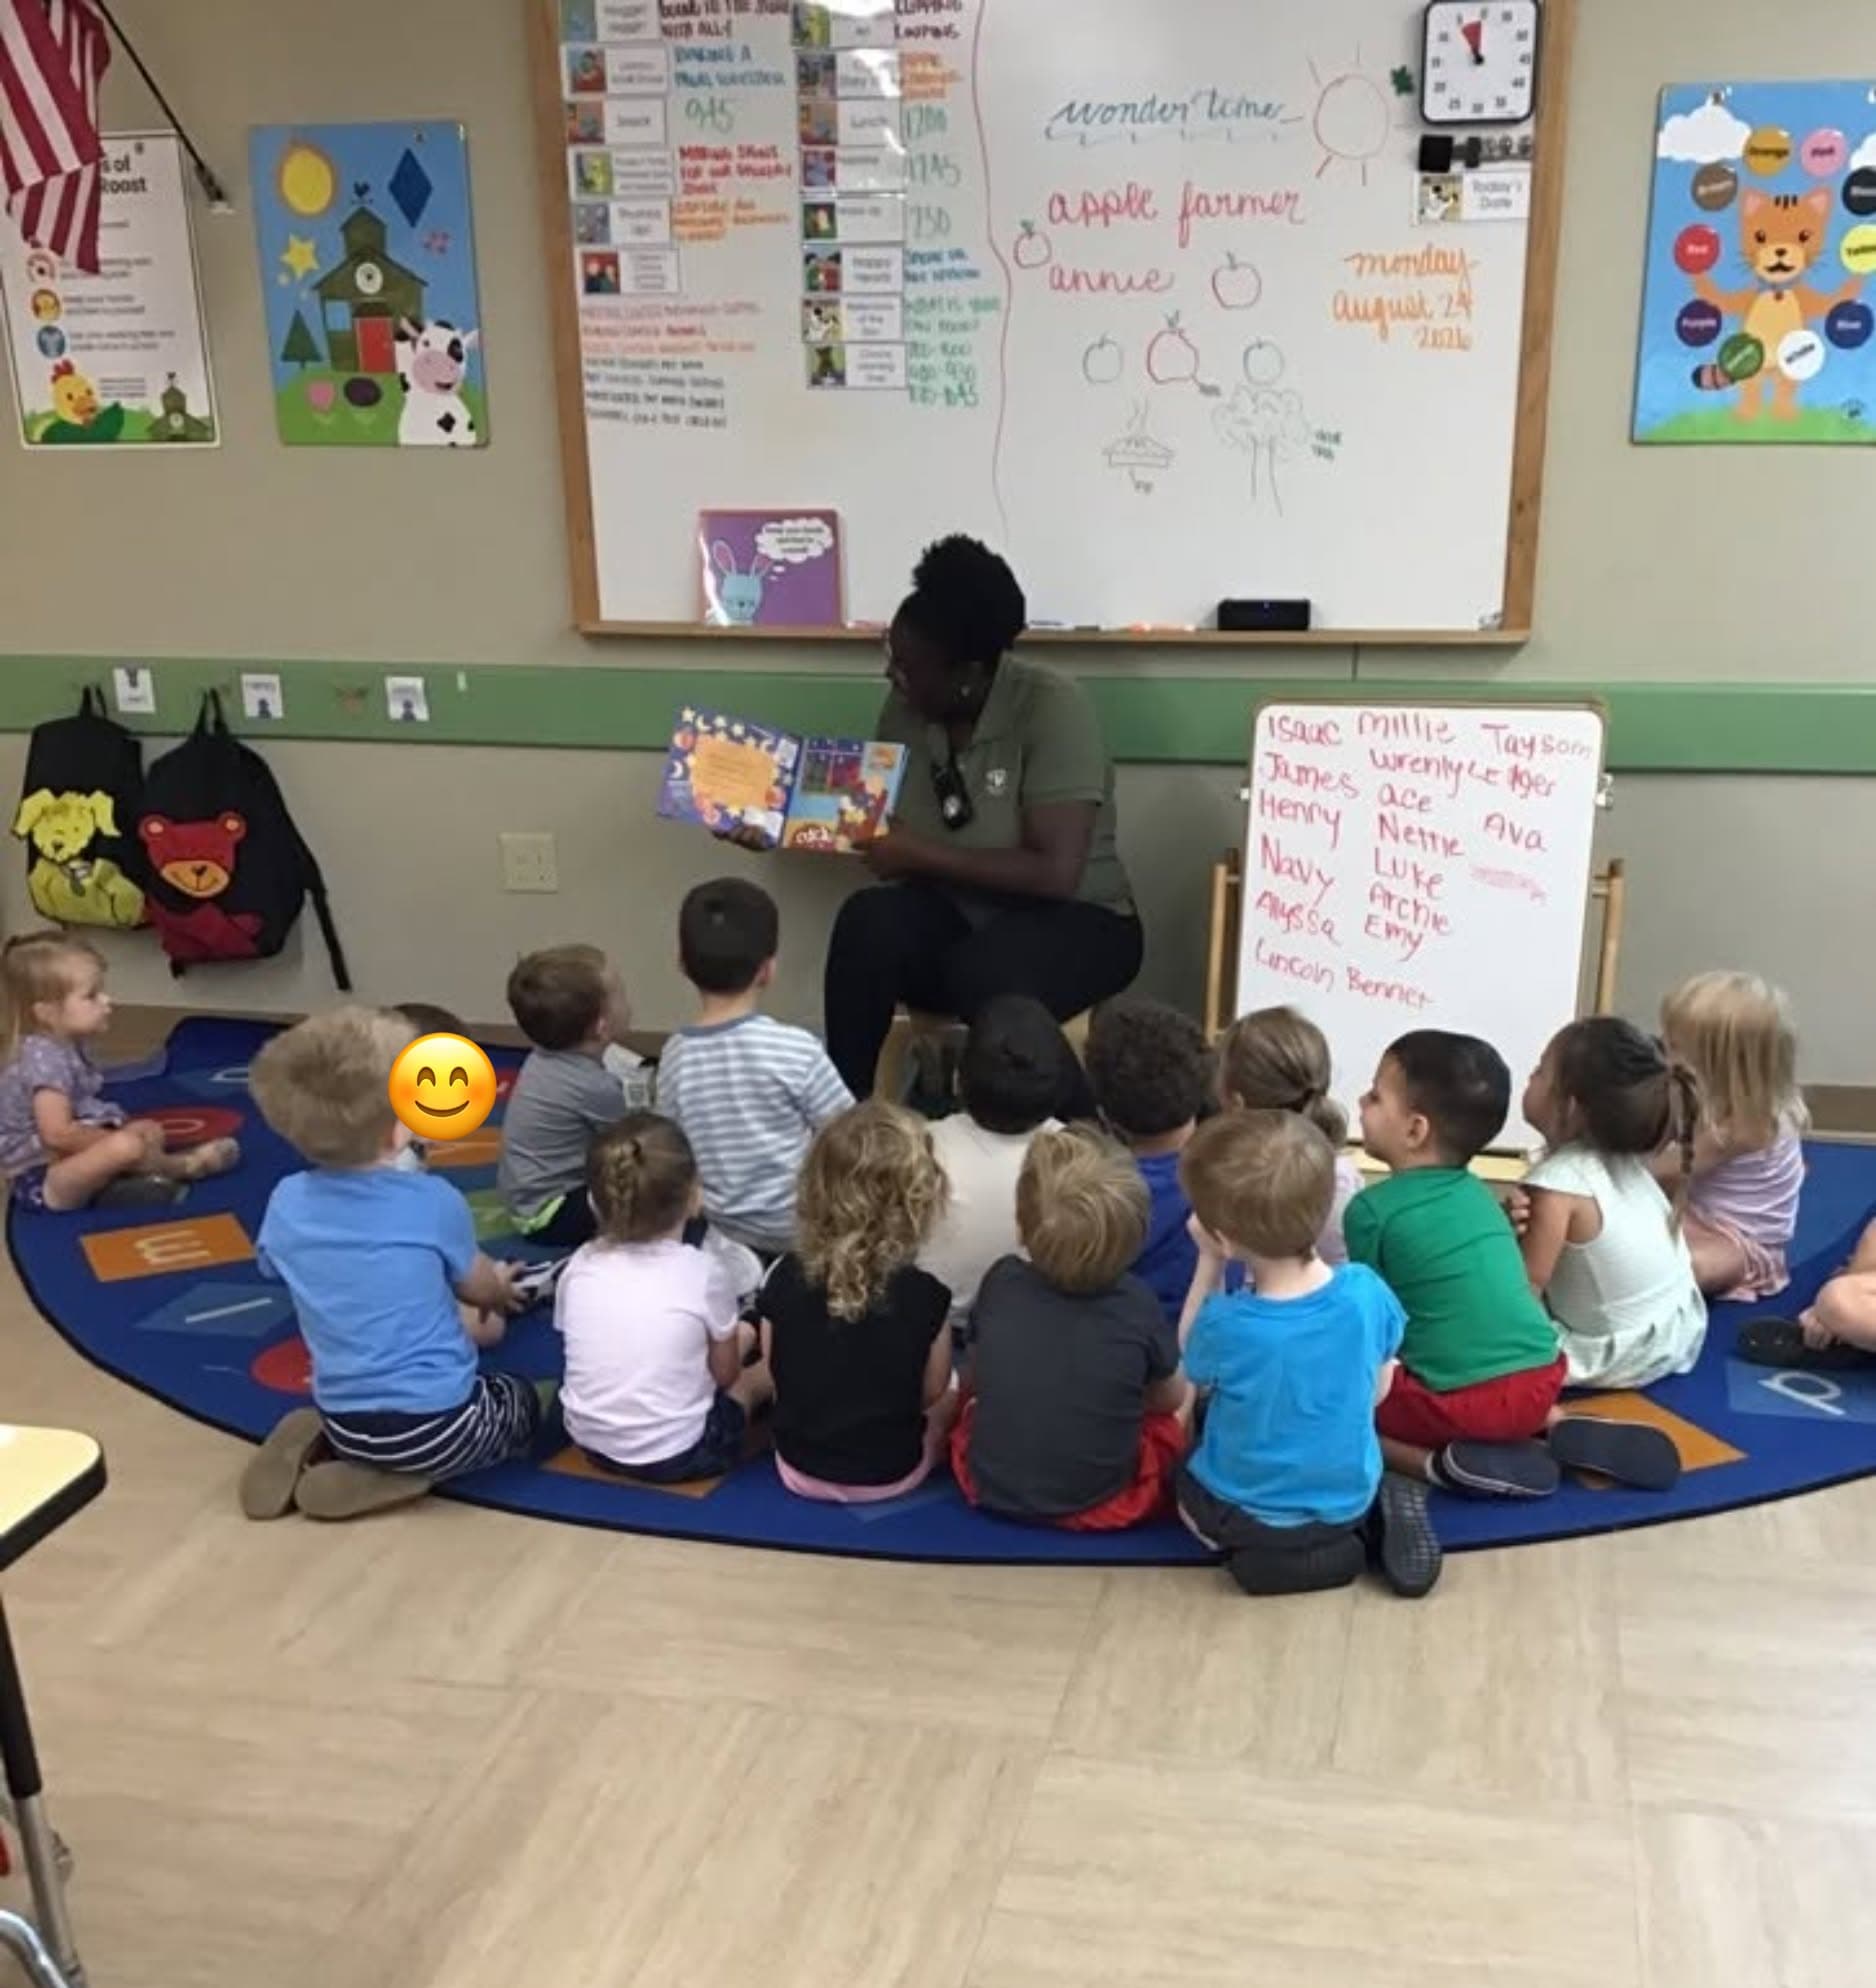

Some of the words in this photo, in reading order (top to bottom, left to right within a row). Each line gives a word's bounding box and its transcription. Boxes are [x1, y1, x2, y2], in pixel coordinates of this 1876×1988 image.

[1049, 181, 1158, 228] apple
[1178, 181, 1305, 249] farmer
[1050, 264, 1175, 294] annie
[1268, 714, 1343, 745] Isaac
[1264, 751, 1360, 799] James
[1260, 788, 1341, 851] Henry
[1483, 811, 1547, 853] Ava
[1261, 833, 1335, 909] Navy
[1374, 847, 1443, 900] Luke
[1256, 890, 1343, 947] Alyssa
[1369, 881, 1453, 937] Archie
[1255, 936, 1335, 993] Lincoln
